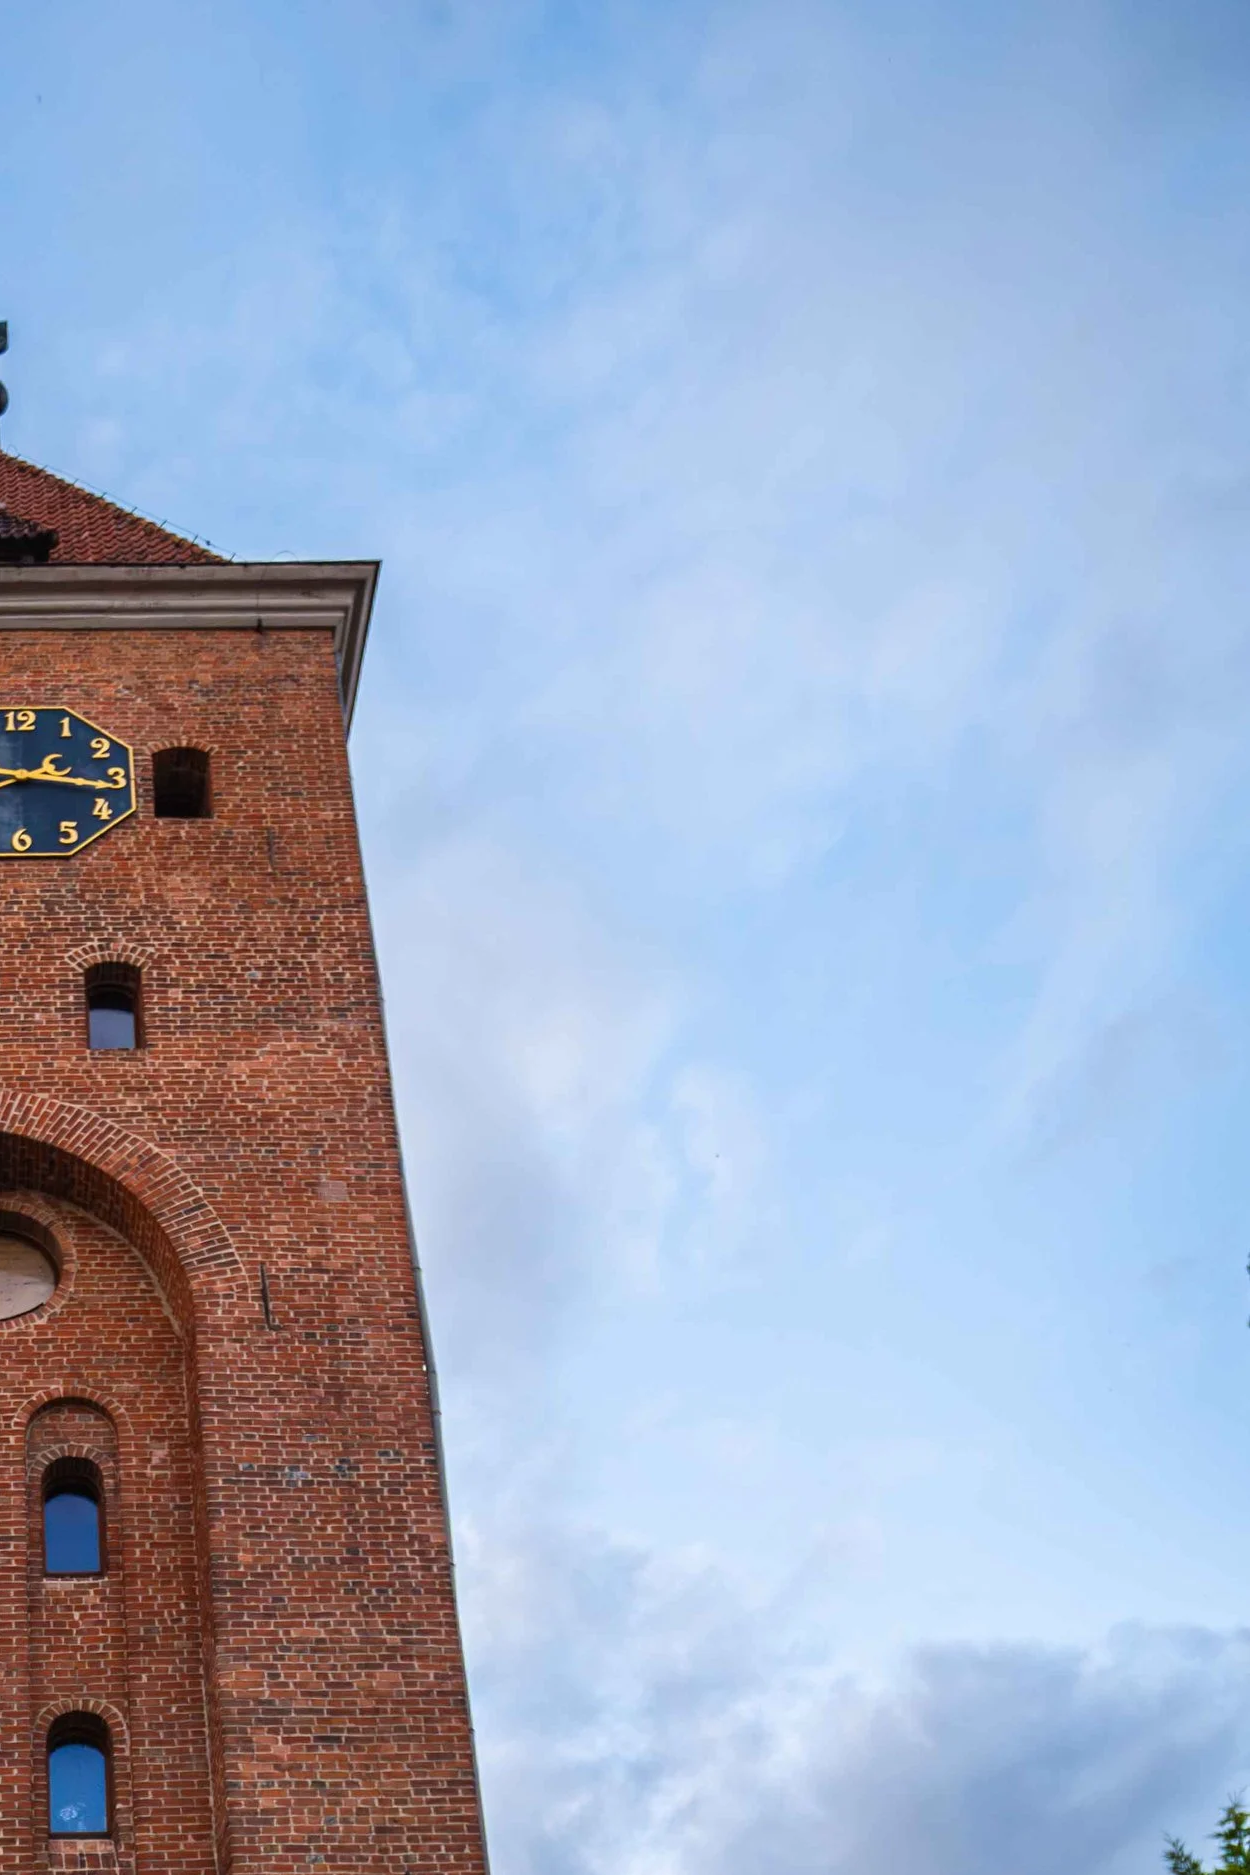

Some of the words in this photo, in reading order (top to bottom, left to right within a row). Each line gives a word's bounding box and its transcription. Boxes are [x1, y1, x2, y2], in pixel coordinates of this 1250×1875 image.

[5, 711, 36, 731] 12
[59, 717, 72, 737] 1
[90, 738, 110, 759] 2
[107, 767, 127, 789] 3
[92, 798, 112, 820] 4
[12, 828, 32, 851] 6
[59, 821, 78, 844] 5
